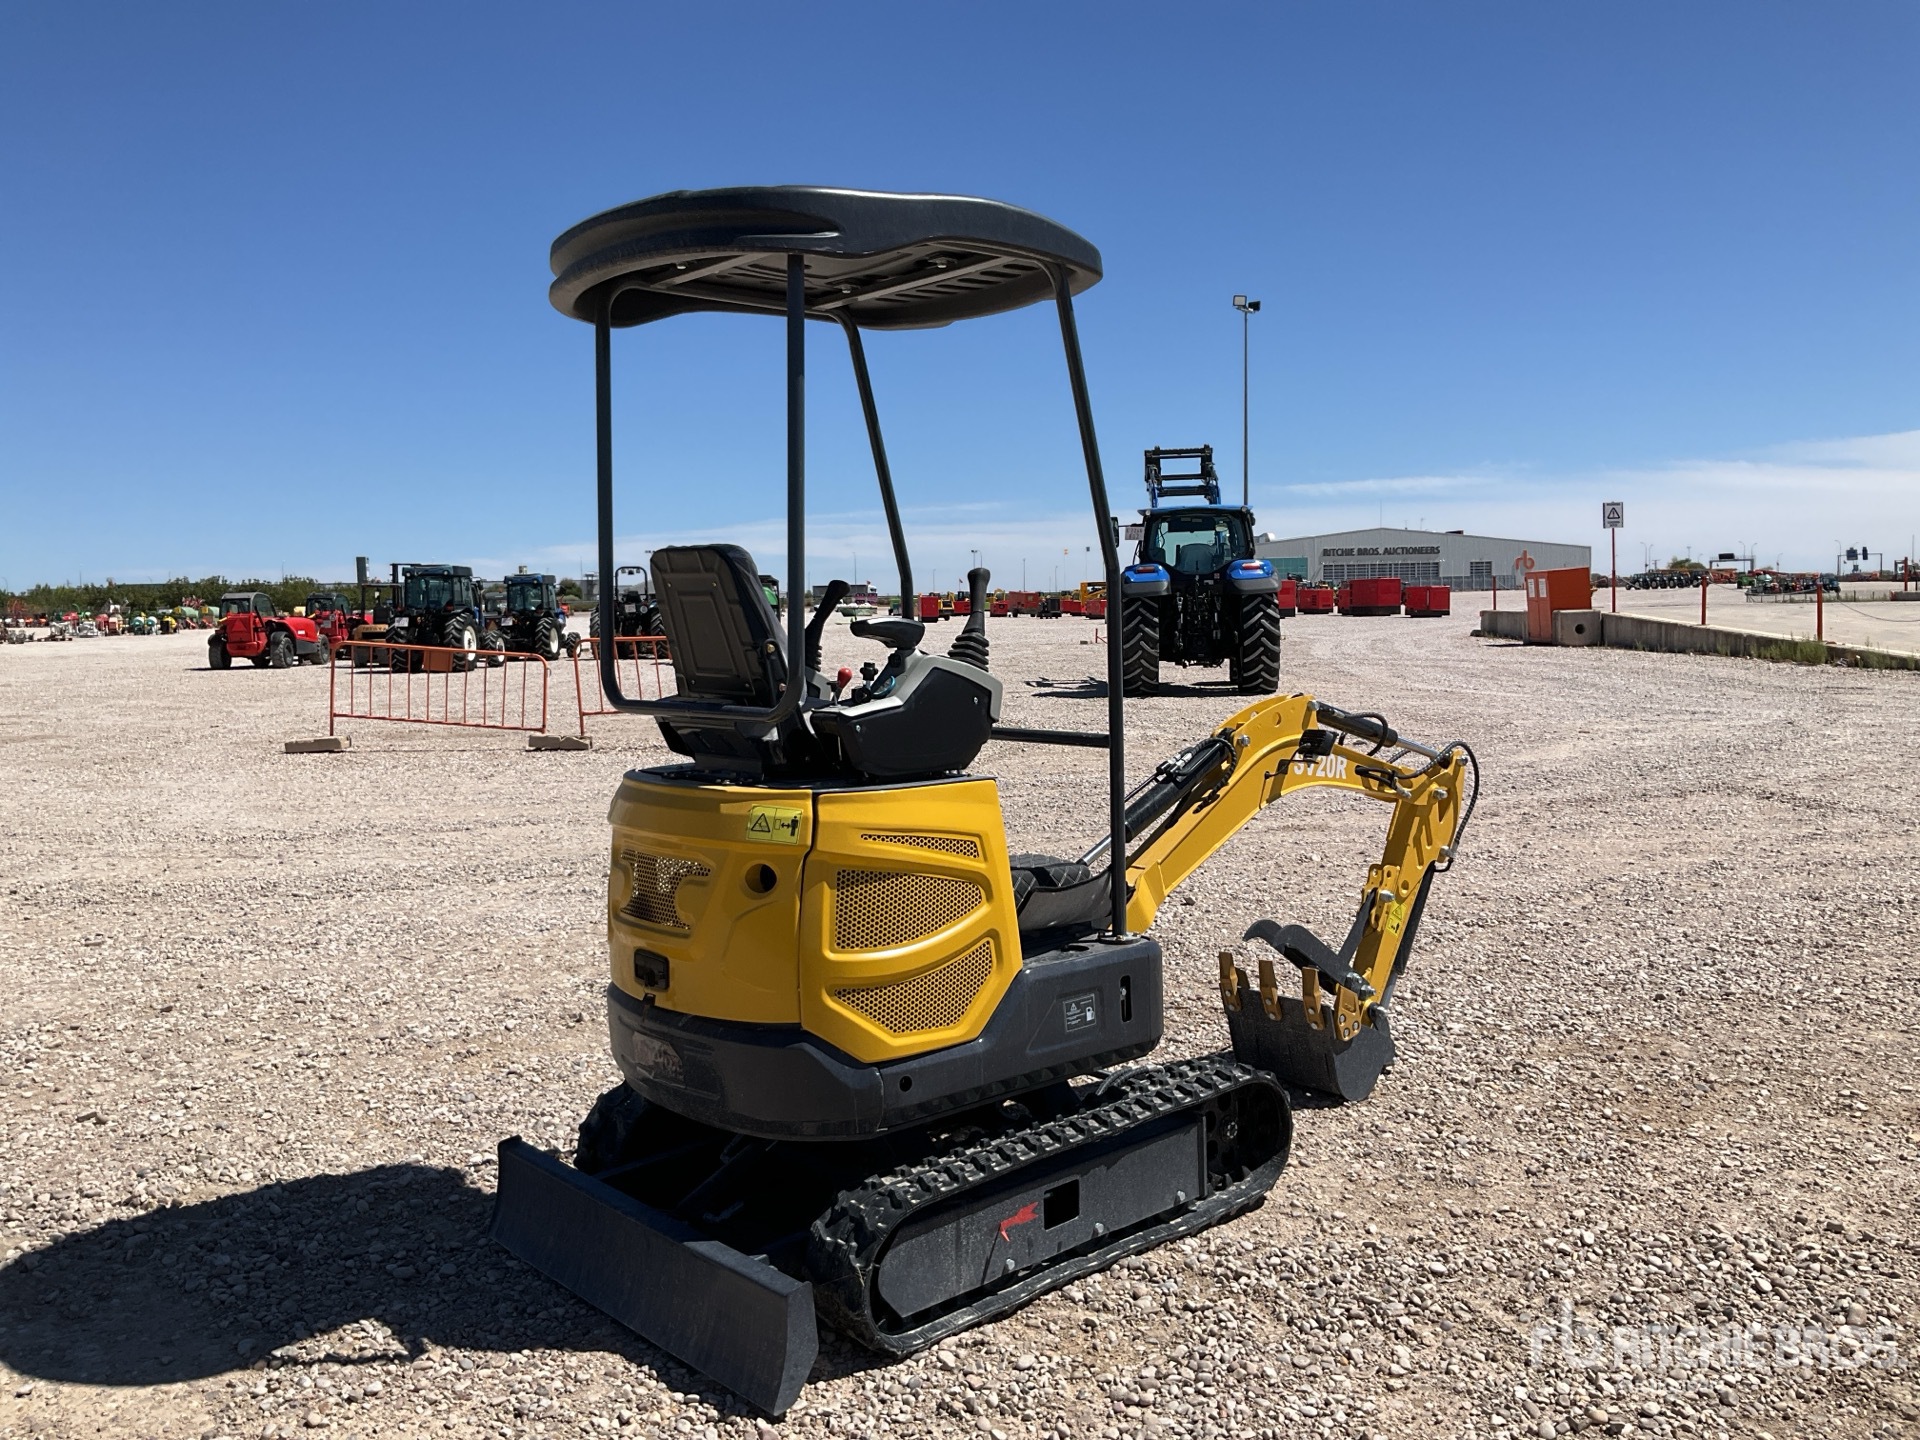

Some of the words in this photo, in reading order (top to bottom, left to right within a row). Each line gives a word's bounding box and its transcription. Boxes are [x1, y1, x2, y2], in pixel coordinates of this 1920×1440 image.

[1322, 548, 1355, 557] RITCHIE
[1357, 547, 1382, 556] BROS.
[1383, 546, 1441, 555] AUCTIONEERS
